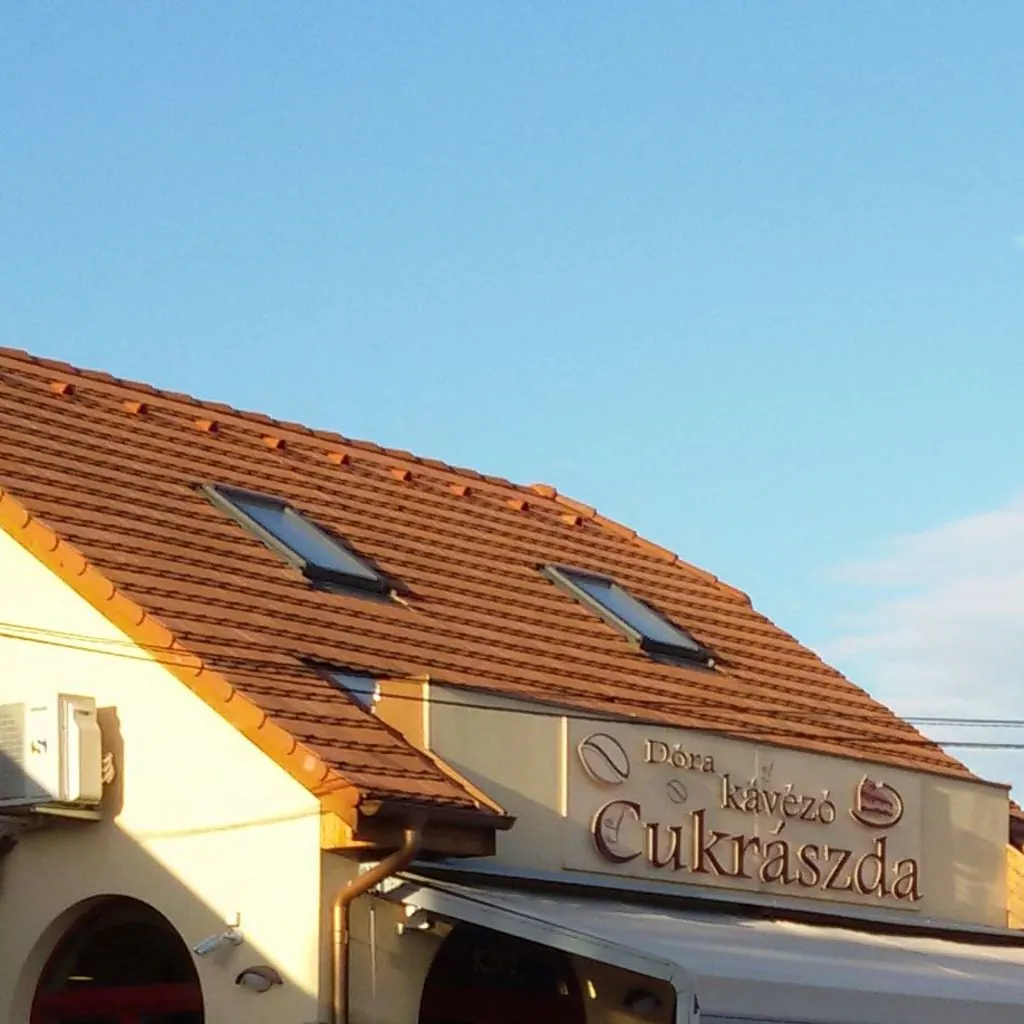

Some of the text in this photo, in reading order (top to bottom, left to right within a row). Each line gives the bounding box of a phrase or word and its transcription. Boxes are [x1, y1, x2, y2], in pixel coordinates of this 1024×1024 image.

[643, 738, 716, 774] Dóra
[720, 772, 836, 825] kávézó
[589, 799, 924, 902] Cukrászda
